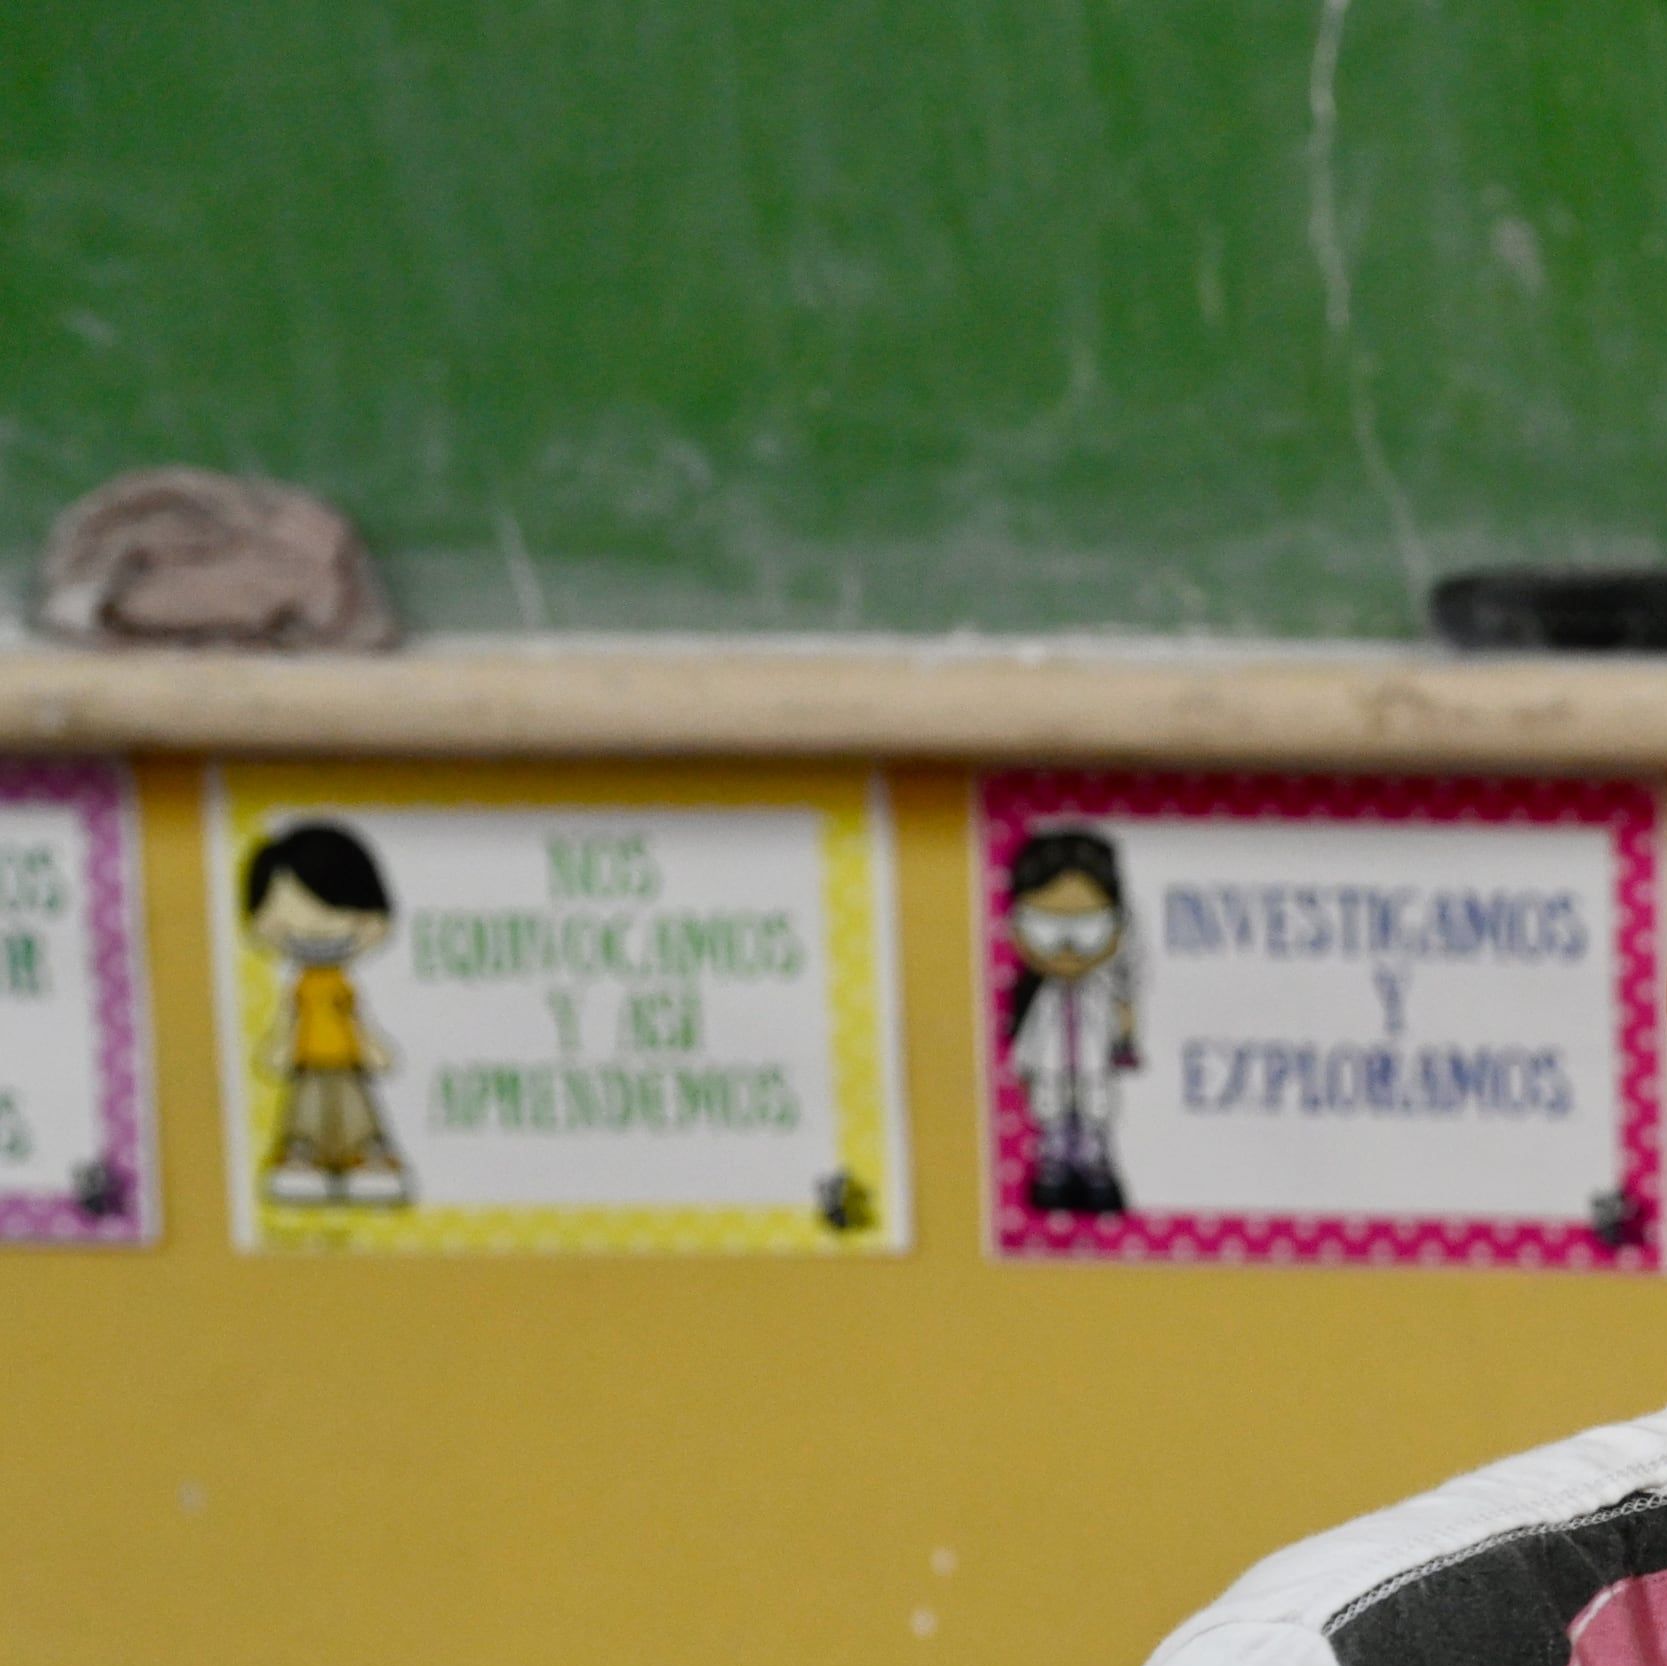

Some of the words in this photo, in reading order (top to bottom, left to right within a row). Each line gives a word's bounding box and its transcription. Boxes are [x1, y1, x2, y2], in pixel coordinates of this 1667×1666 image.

[412, 910, 807, 980] EQUIVOCAMOS
[1163, 882, 1590, 962] INVESTIGAMOS
[545, 986, 584, 1055] Y
[1372, 962, 1413, 1036] Y
[430, 1062, 803, 1136] APRENDEMOS
[1182, 1036, 1576, 1120] EXPLORAMOS
